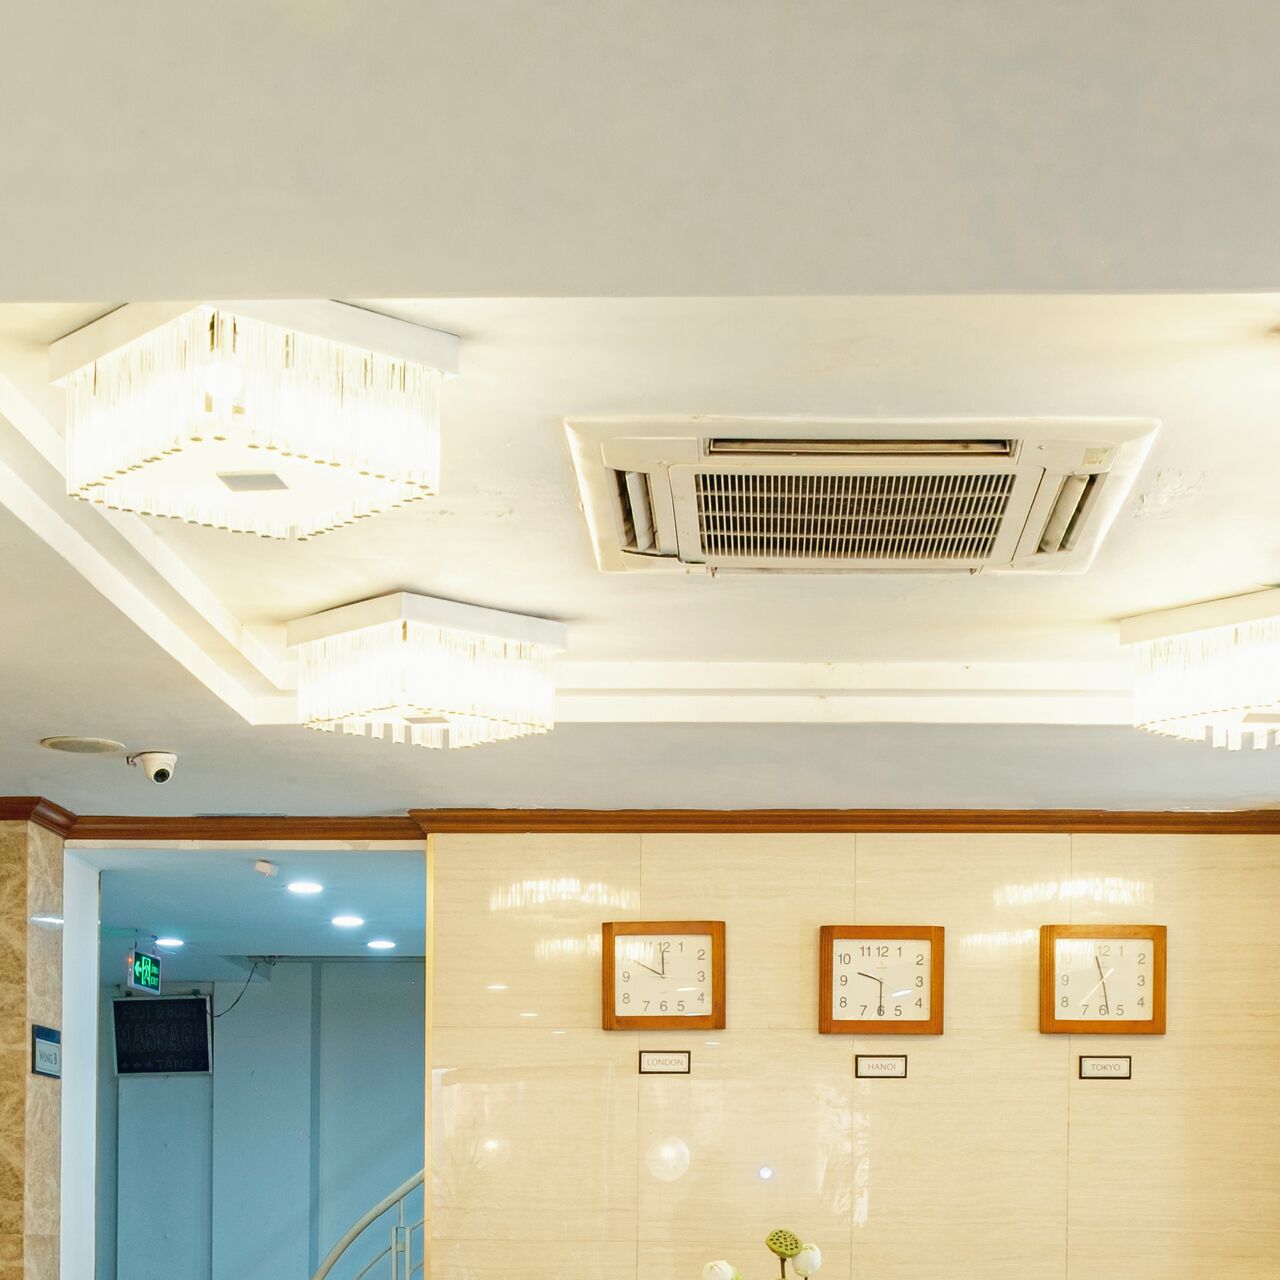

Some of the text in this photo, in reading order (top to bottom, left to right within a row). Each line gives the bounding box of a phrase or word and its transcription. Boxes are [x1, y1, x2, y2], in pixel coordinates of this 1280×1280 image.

[658, 941, 670, 952] 12
[860, 946, 871, 957] 11
[876, 946, 888, 957] 12
[897, 947, 902, 957] 1
[1098, 945, 1110, 956] 12
[697, 949, 705, 960] 2
[838, 954, 851, 964] 10
[916, 954, 924, 966] 2
[1137, 953, 1146, 965] 2
[622, 971, 630, 982] 9
[697, 971, 705, 982] 3
[840, 975, 848, 986] 9
[915, 976, 924, 988] 3
[1061, 974, 1069, 986] 9
[1137, 975, 1146, 986] 3
[622, 993, 630, 1004] 8
[697, 992, 705, 1004] 4
[840, 997, 848, 1008] 8
[915, 998, 922, 1008] 4
[1061, 996, 1069, 1008] 8
[1136, 996, 1144, 1008] 4
[642, 1000, 650, 1012] 7
[660, 1000, 668, 1012] 6
[677, 1000, 684, 1012] 5
[860, 1005, 867, 1016] 7
[877, 1005, 884, 1016] 6
[894, 1005, 902, 1016] 5
[1081, 1004, 1089, 1016] 7
[1099, 1004, 1107, 1016] 6
[1116, 1004, 1124, 1016] 5
[646, 1057, 684, 1066] LONDON
[867, 1063, 896, 1071] HANOI
[1090, 1063, 1120, 1072] TOKYO
